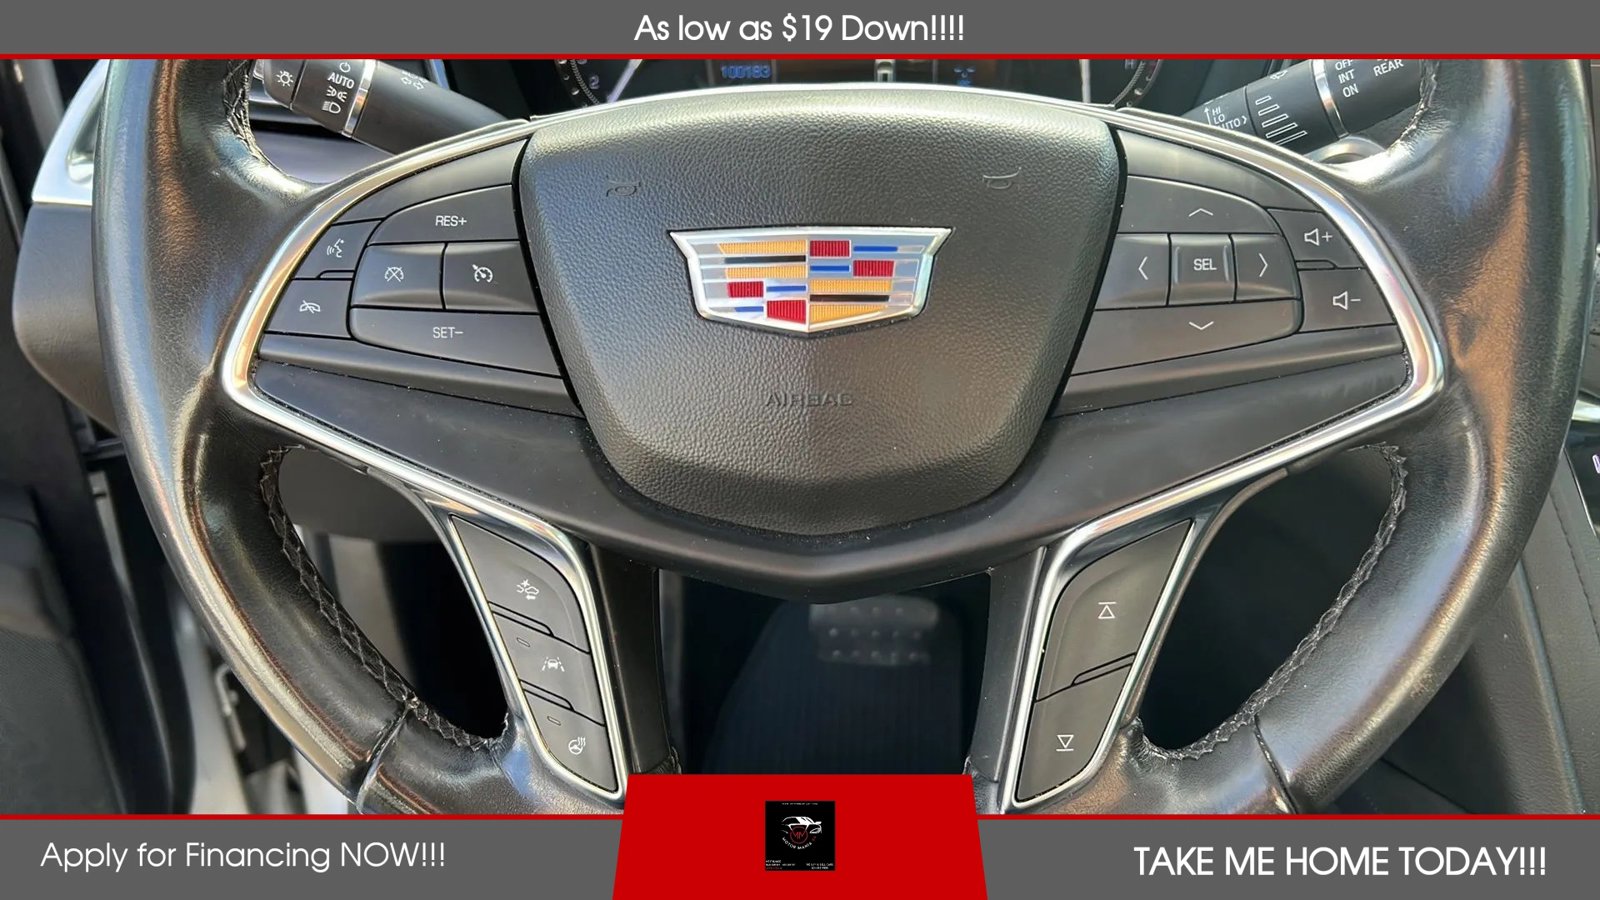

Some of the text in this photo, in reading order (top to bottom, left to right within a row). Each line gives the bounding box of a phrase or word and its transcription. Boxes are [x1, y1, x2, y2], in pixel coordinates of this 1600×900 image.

[1373, 59, 1405, 77] REAR
[327, 72, 355, 89] AUTO
[1337, 69, 1355, 85] INT
[1342, 84, 1359, 98] ON
[1212, 105, 1221, 116] HI
[1213, 114, 1225, 125] LO
[1193, 258, 1217, 271] SEL
[766, 391, 853, 407] AIRBAG
